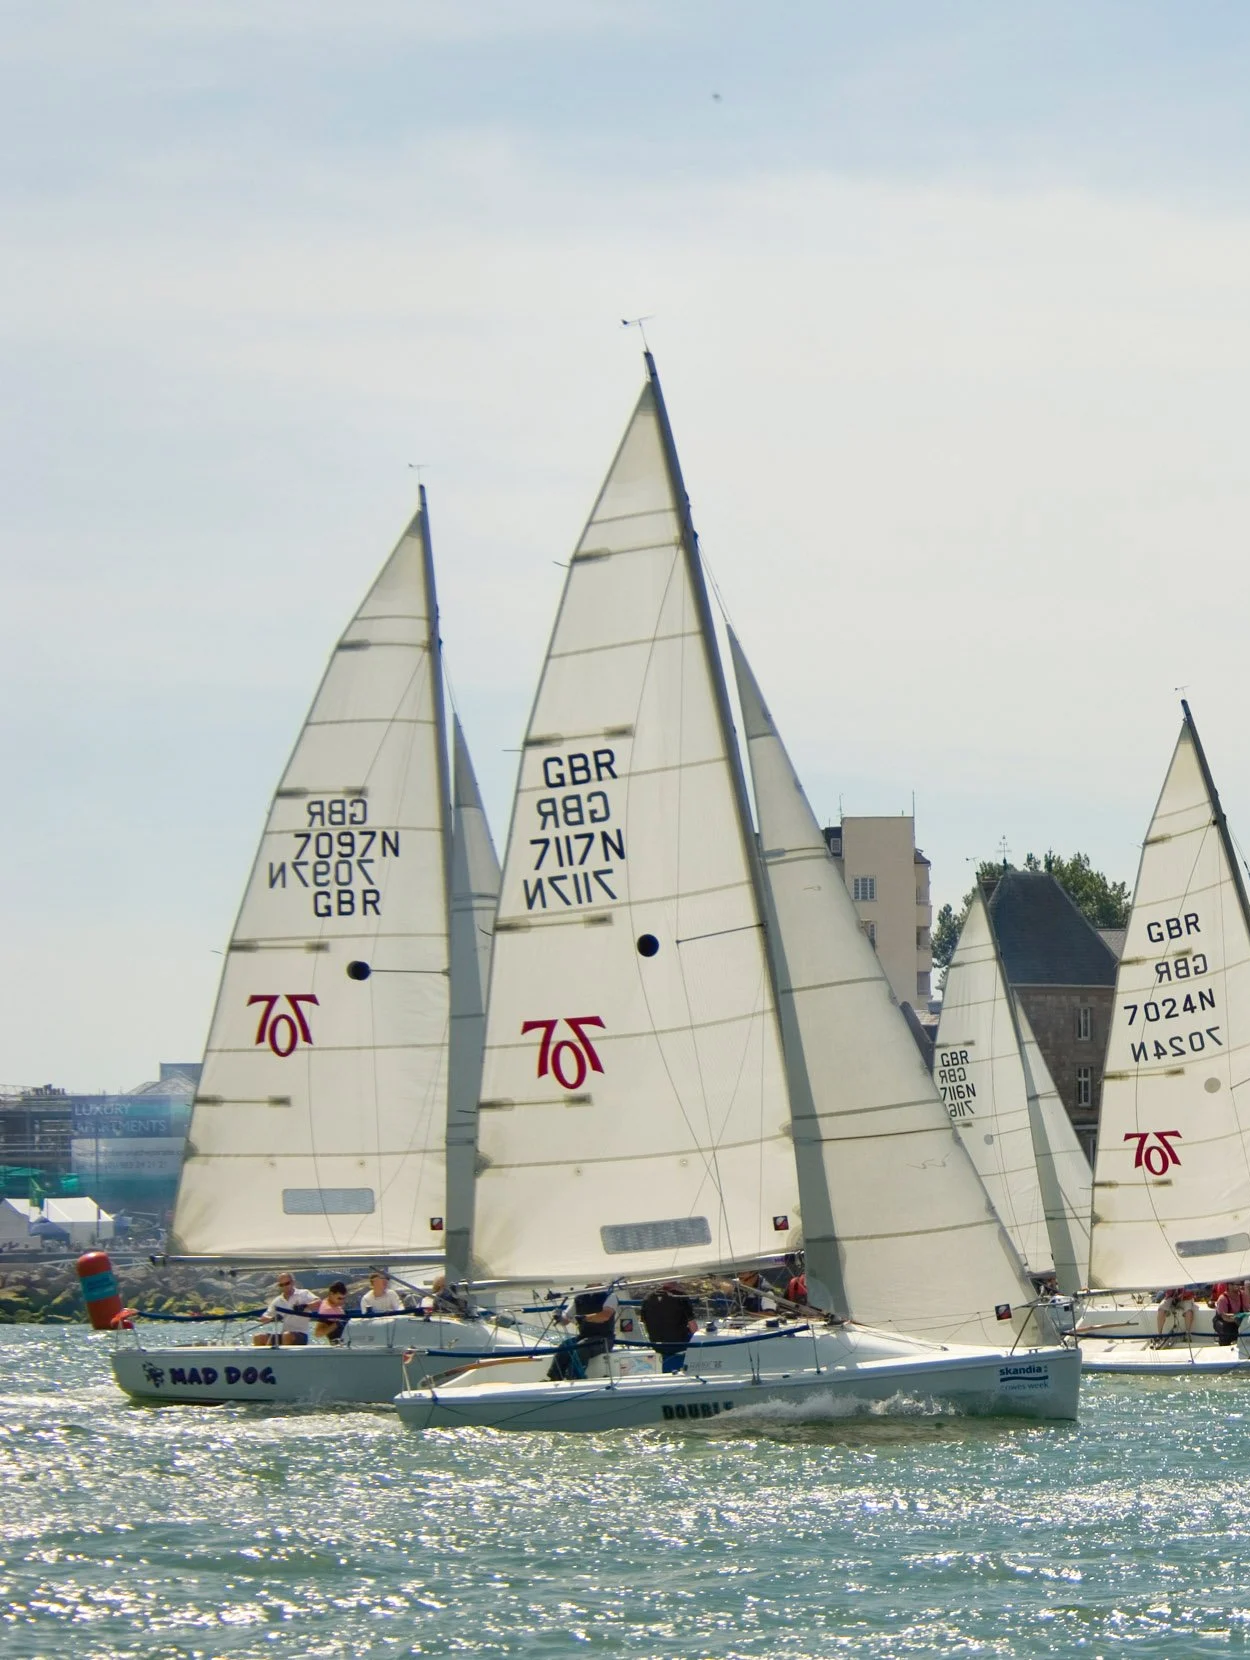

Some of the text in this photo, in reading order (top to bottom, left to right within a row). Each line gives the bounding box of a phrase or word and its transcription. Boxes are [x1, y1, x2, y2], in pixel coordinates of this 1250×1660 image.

[543, 749, 618, 788] GBR
[294, 831, 399, 859] 7097N
[530, 829, 625, 870] 7117N
[313, 889, 381, 917] GBR
[1146, 913, 1201, 943] GBR
[1124, 988, 1216, 1025] 7024N
[246, 994, 320, 1057] 707
[521, 1015, 606, 1089] 707
[940, 1050, 969, 1067] GBR
[940, 1083, 976, 1101] 7116N
[74, 1103, 131, 1116] LUXURY
[1123, 1130, 1183, 1176] 707
[169, 1366, 276, 1385] MAD DOG
